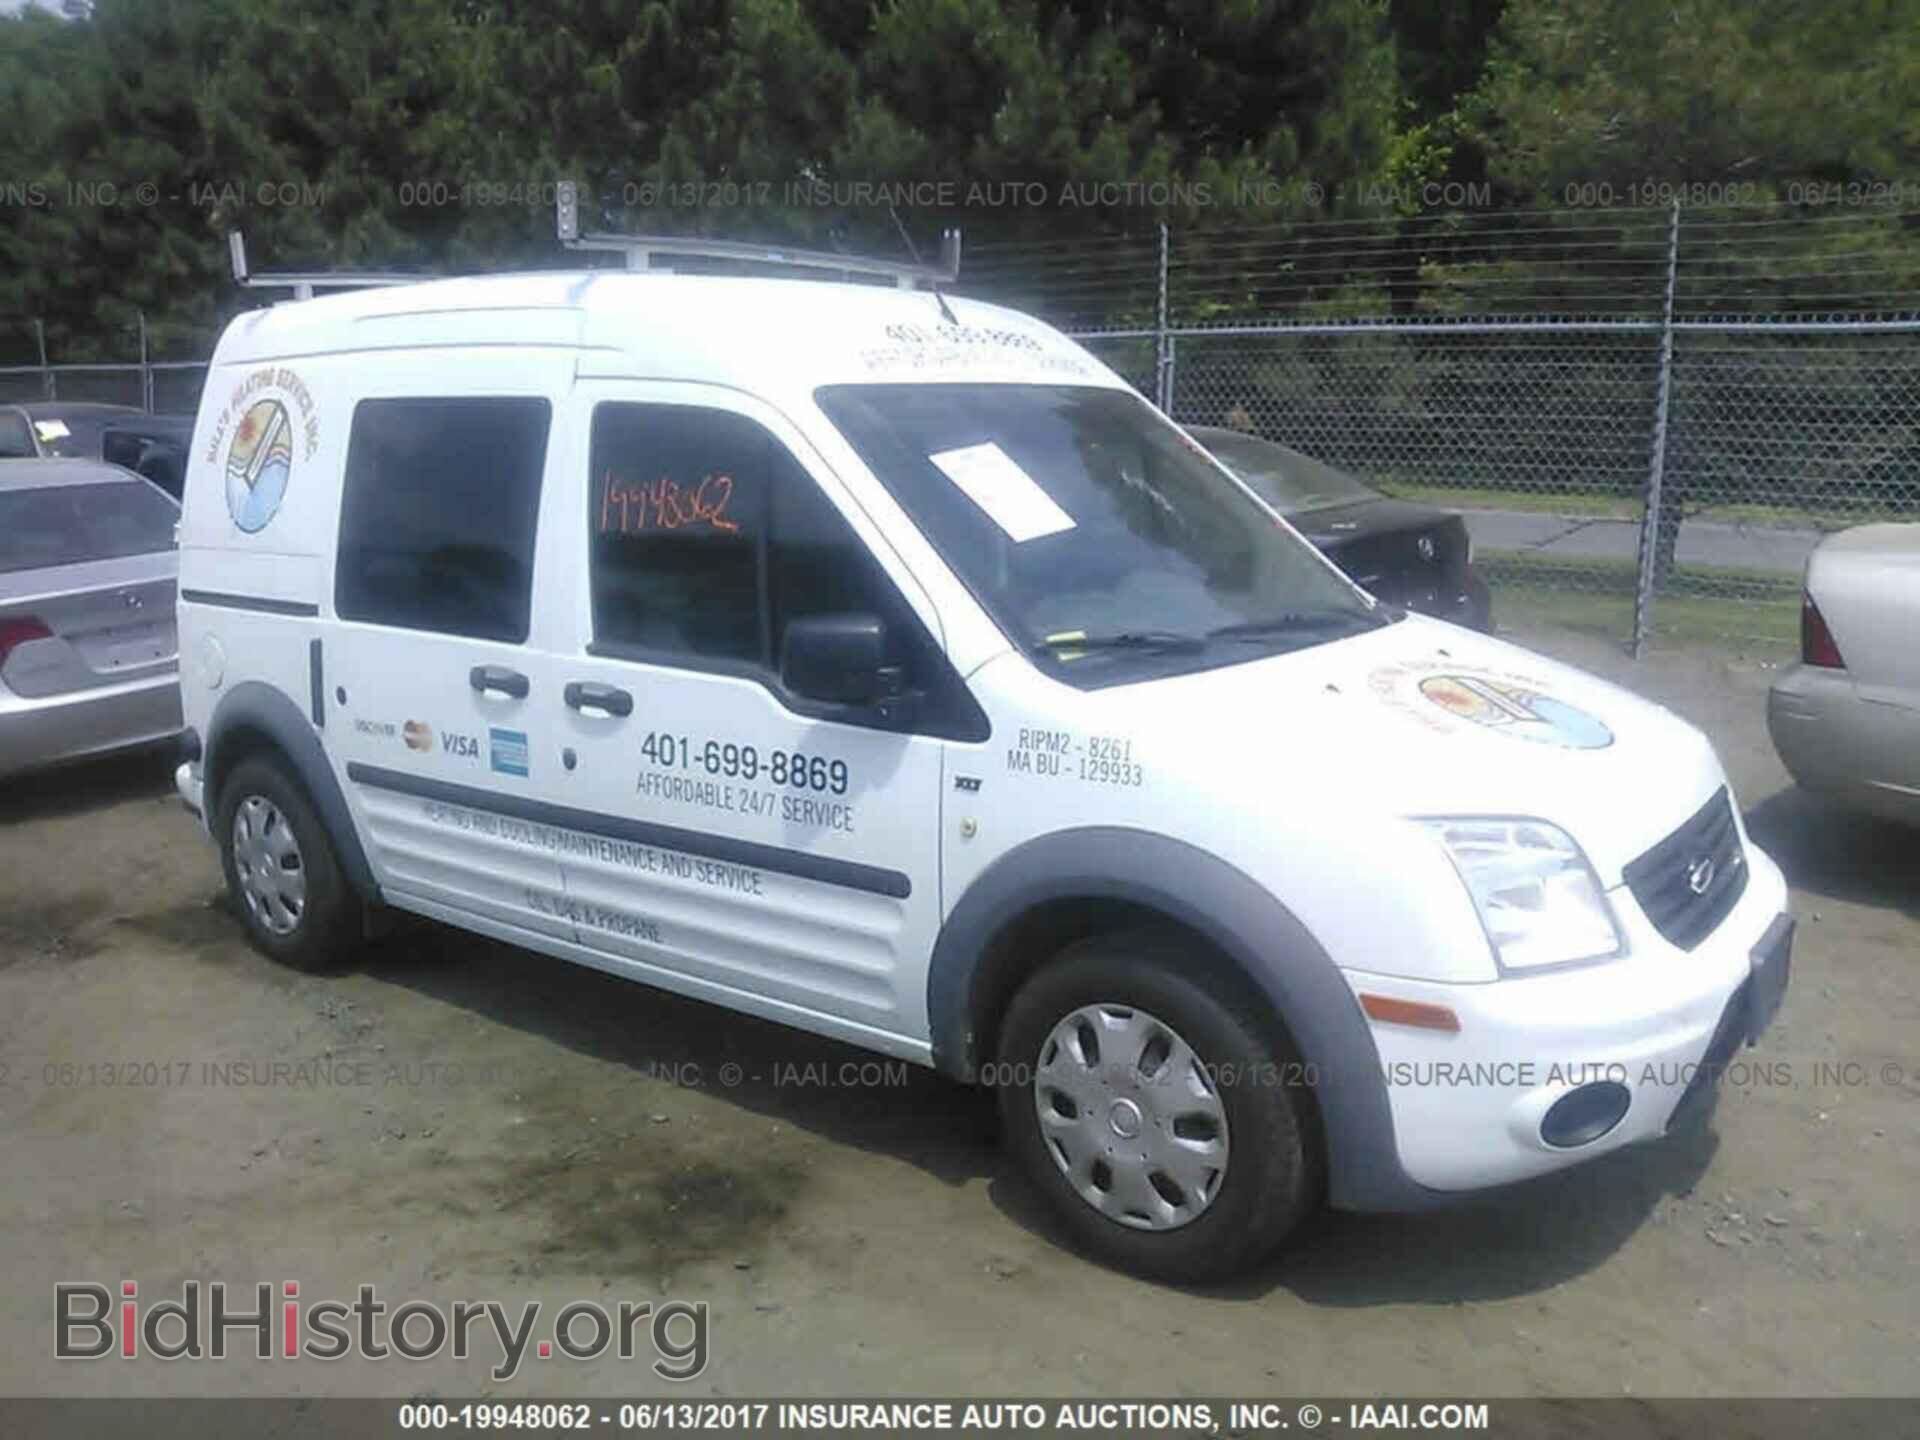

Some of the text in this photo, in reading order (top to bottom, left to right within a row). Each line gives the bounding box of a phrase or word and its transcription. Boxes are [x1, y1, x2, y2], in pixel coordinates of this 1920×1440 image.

[440, 731, 480, 758] VISA
[640, 731, 849, 796] 401-699-8869
[1007, 750, 1031, 774] MA
[1036, 753, 1060, 777] BU
[1080, 757, 1143, 787] 129933
[1018, 728, 1071, 755] RIPM2
[1088, 736, 1132, 762] 8261
[636, 772, 855, 833] AFFORDABLE 24/7 SERVICE
[556, 830, 659, 874] MAINTENANCE
[661, 848, 692, 880] AND
[697, 860, 763, 896] SERVICE
